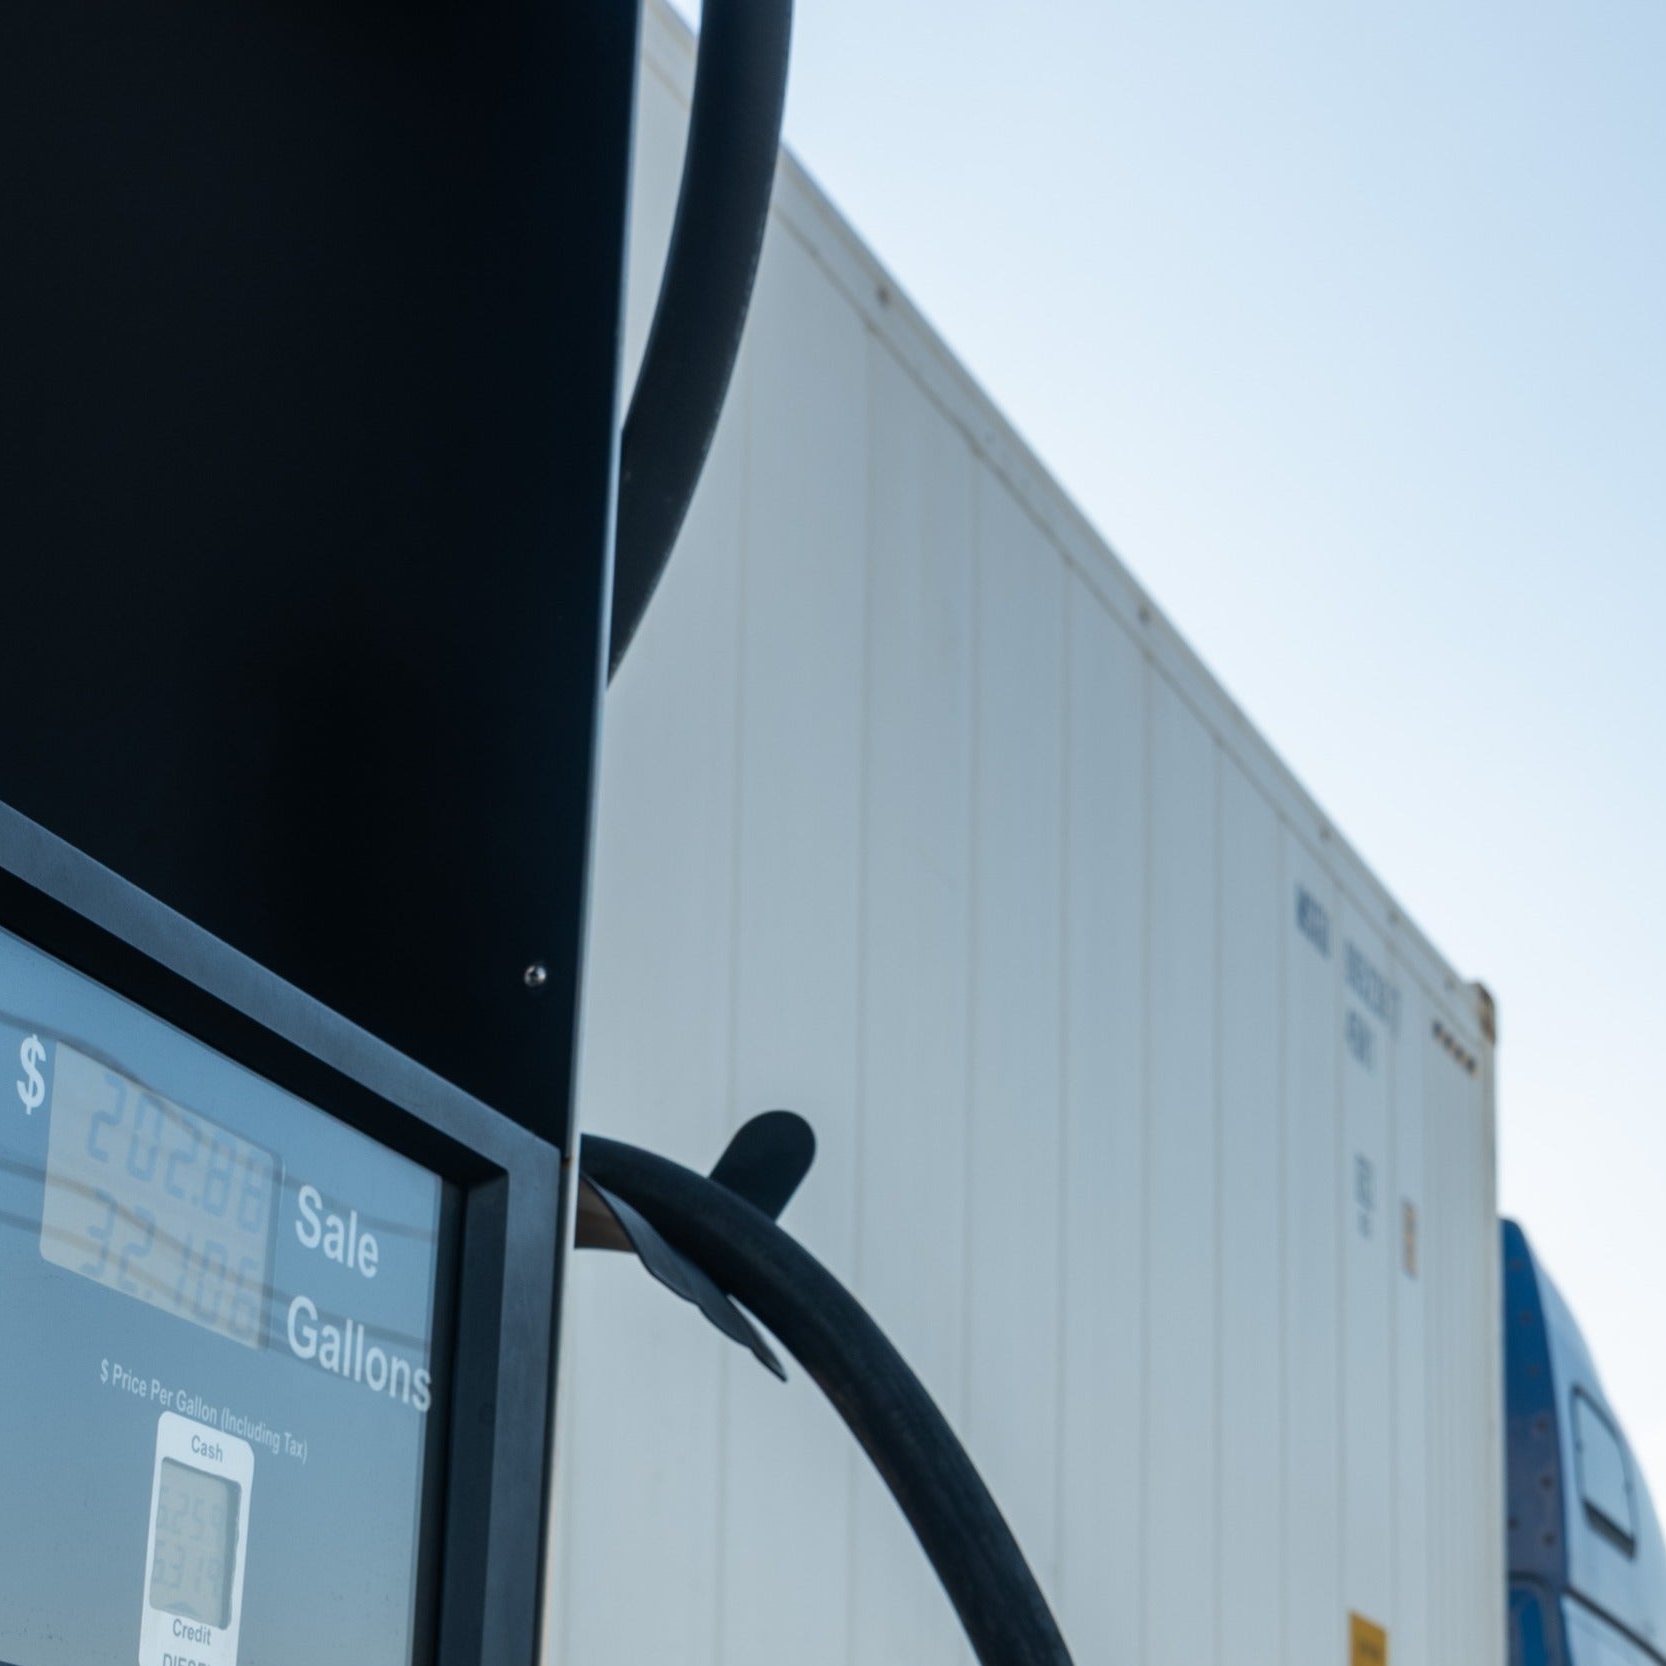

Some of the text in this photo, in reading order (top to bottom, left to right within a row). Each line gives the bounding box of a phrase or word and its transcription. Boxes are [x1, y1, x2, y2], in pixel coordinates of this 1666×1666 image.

[17, 1034, 47, 1114] $
[294, 1183, 380, 1279] Sale
[286, 1295, 432, 1413] Gallons
[112, 1363, 148, 1398] Price
[150, 1378, 174, 1408] Per
[175, 1389, 218, 1425] Gallon
[220, 1406, 281, 1455] (Including
[283, 1431, 309, 1466] Tax)
[190, 1434, 224, 1464] Cash
[172, 1617, 212, 1648] Credit
